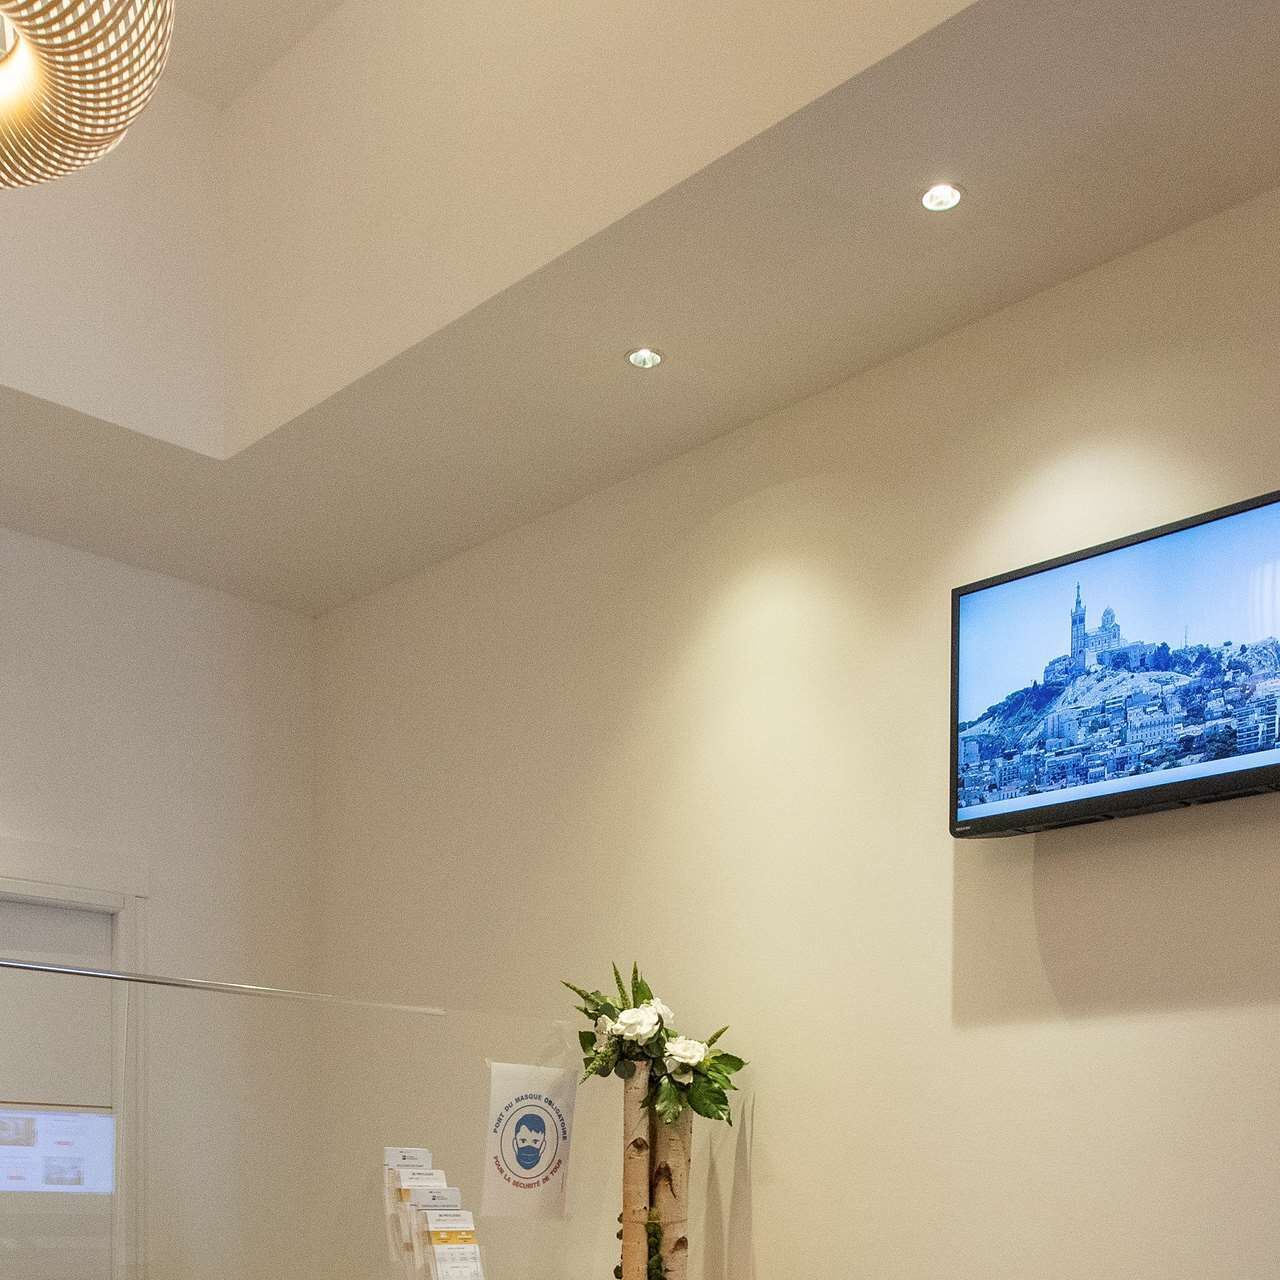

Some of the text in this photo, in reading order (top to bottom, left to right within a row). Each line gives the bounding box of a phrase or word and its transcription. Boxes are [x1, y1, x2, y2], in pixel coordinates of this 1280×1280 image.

[493, 1093, 568, 1141] PORT DU MASQUE OBLIGATOIRE
[493, 1155, 505, 1175] POUR
[549, 1159, 562, 1176] TOUS
